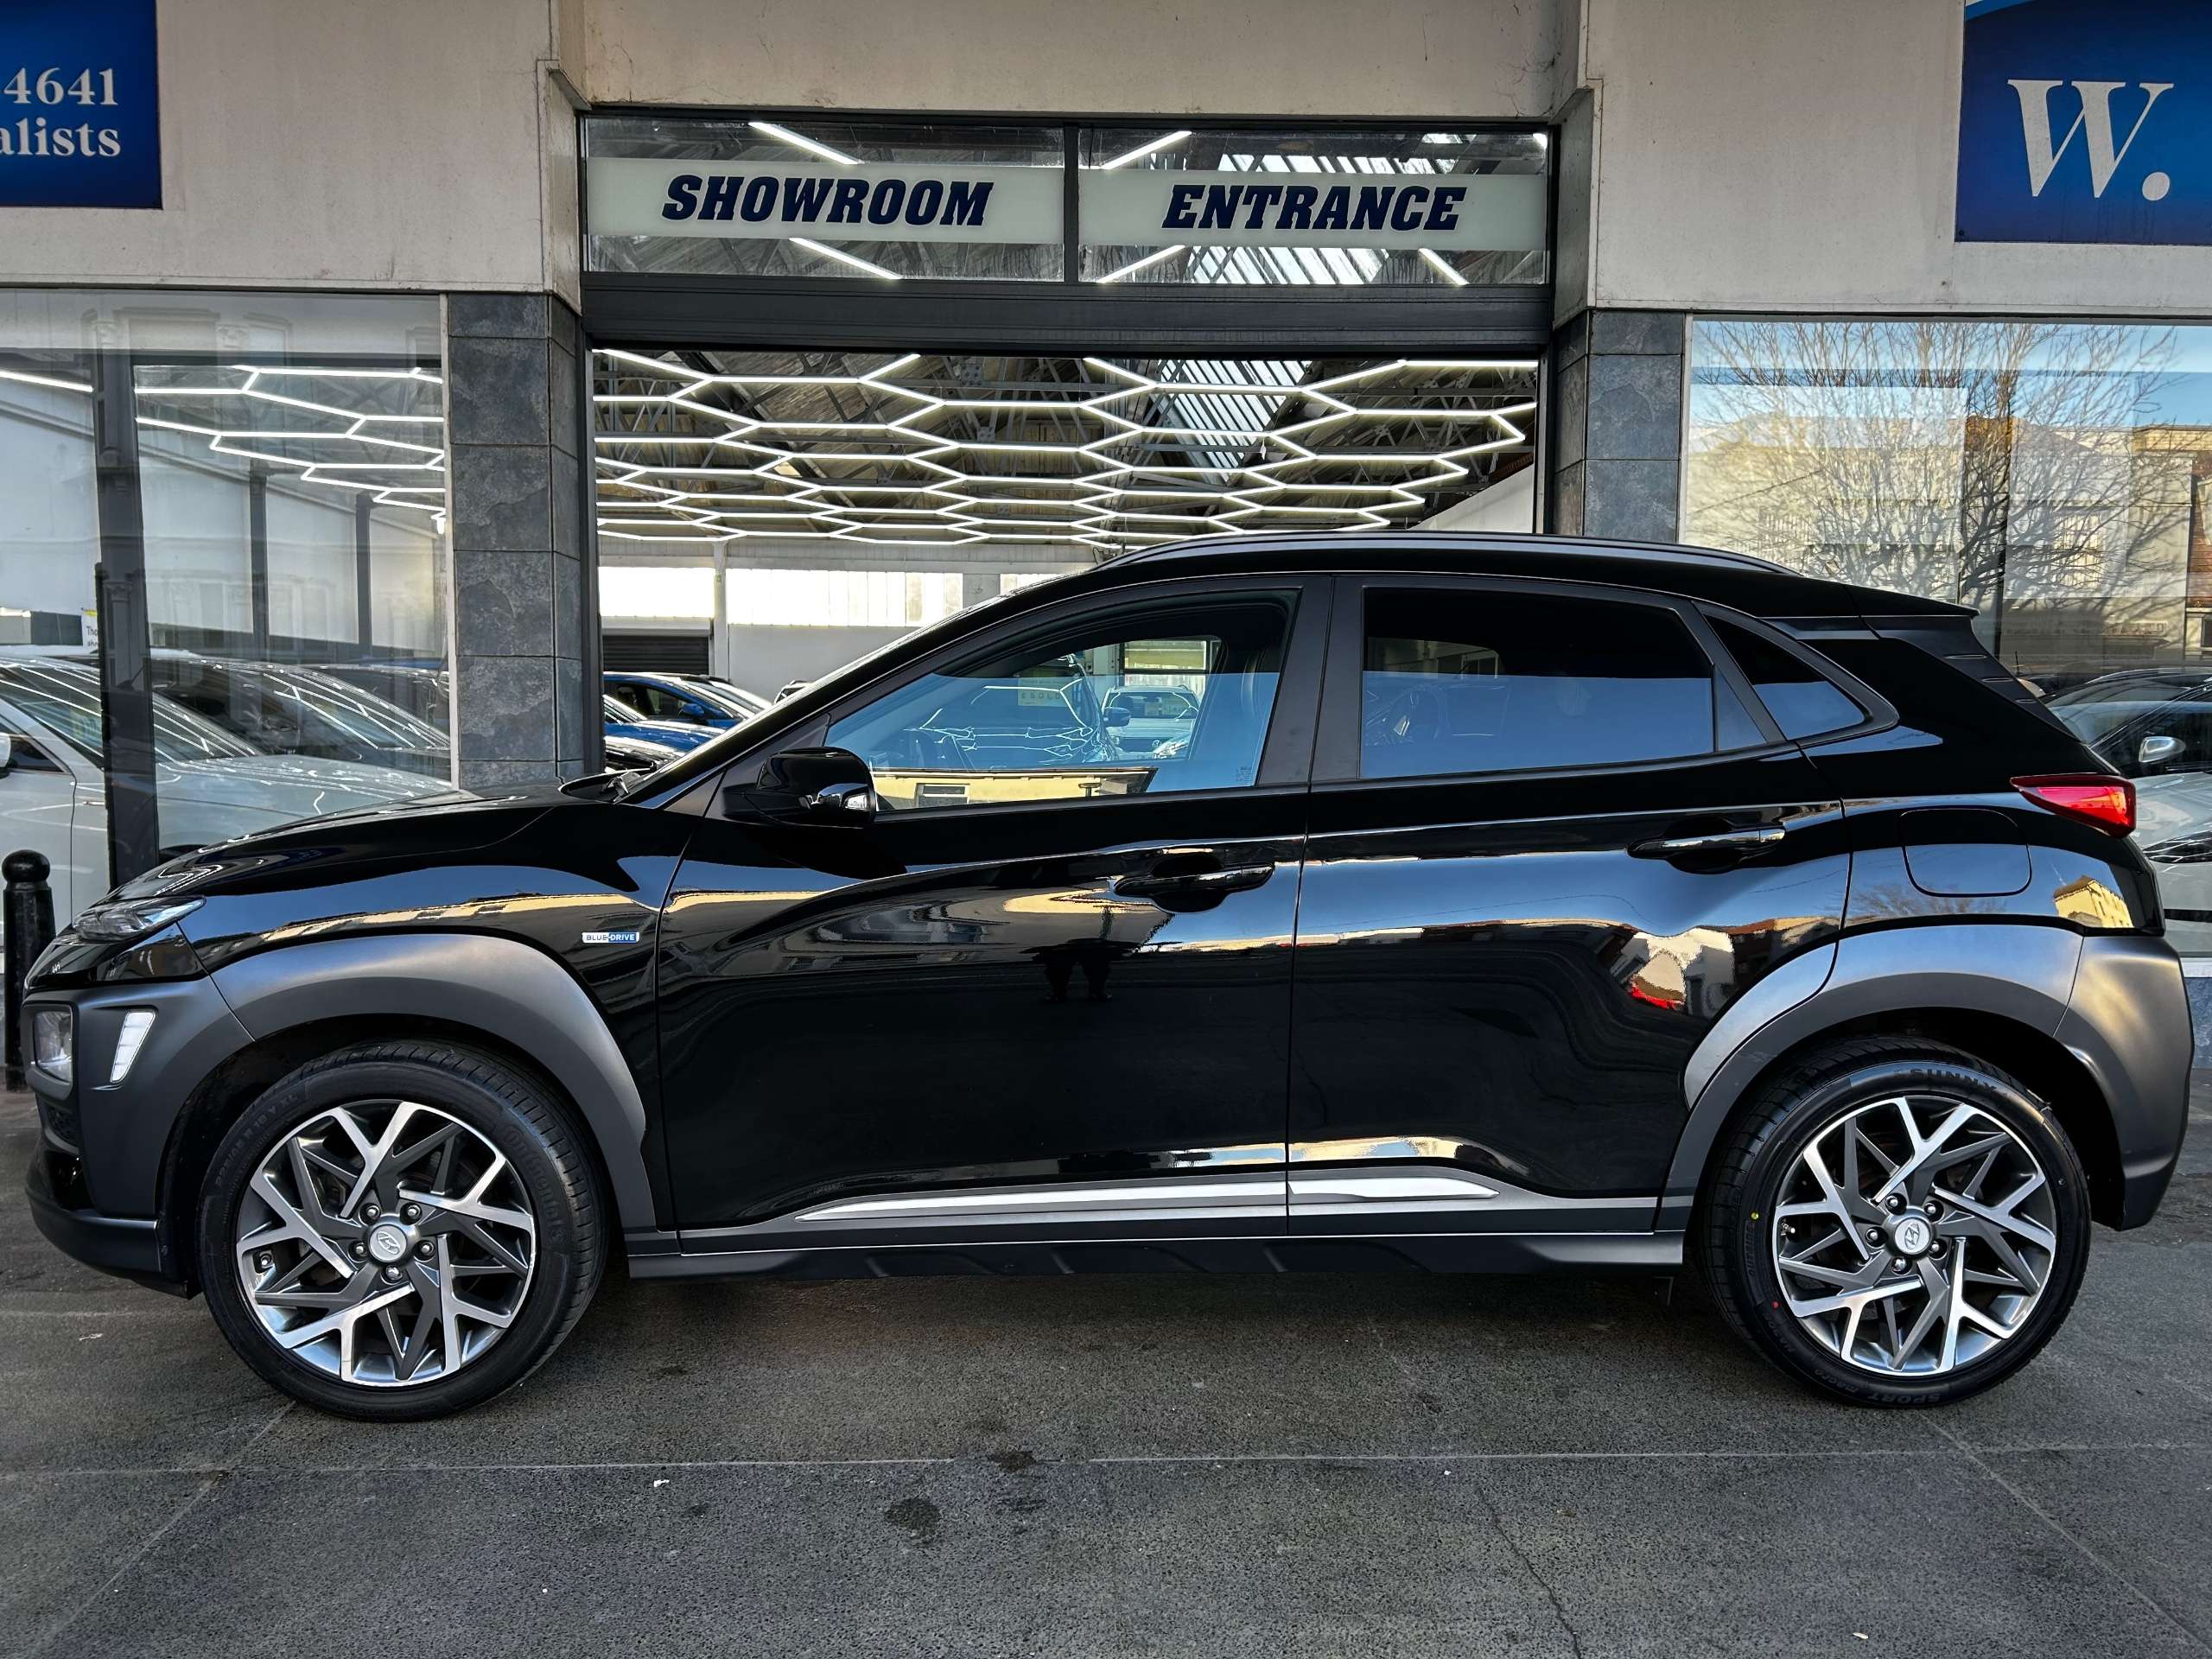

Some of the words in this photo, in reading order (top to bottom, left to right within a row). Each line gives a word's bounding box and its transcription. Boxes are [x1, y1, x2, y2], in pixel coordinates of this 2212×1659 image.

[3, 67, 118, 105] 4641
[2006, 79, 2175, 201] W.
[661, 174, 995, 226] SHOWROOM
[1160, 184, 1468, 232] ENTRANCE
